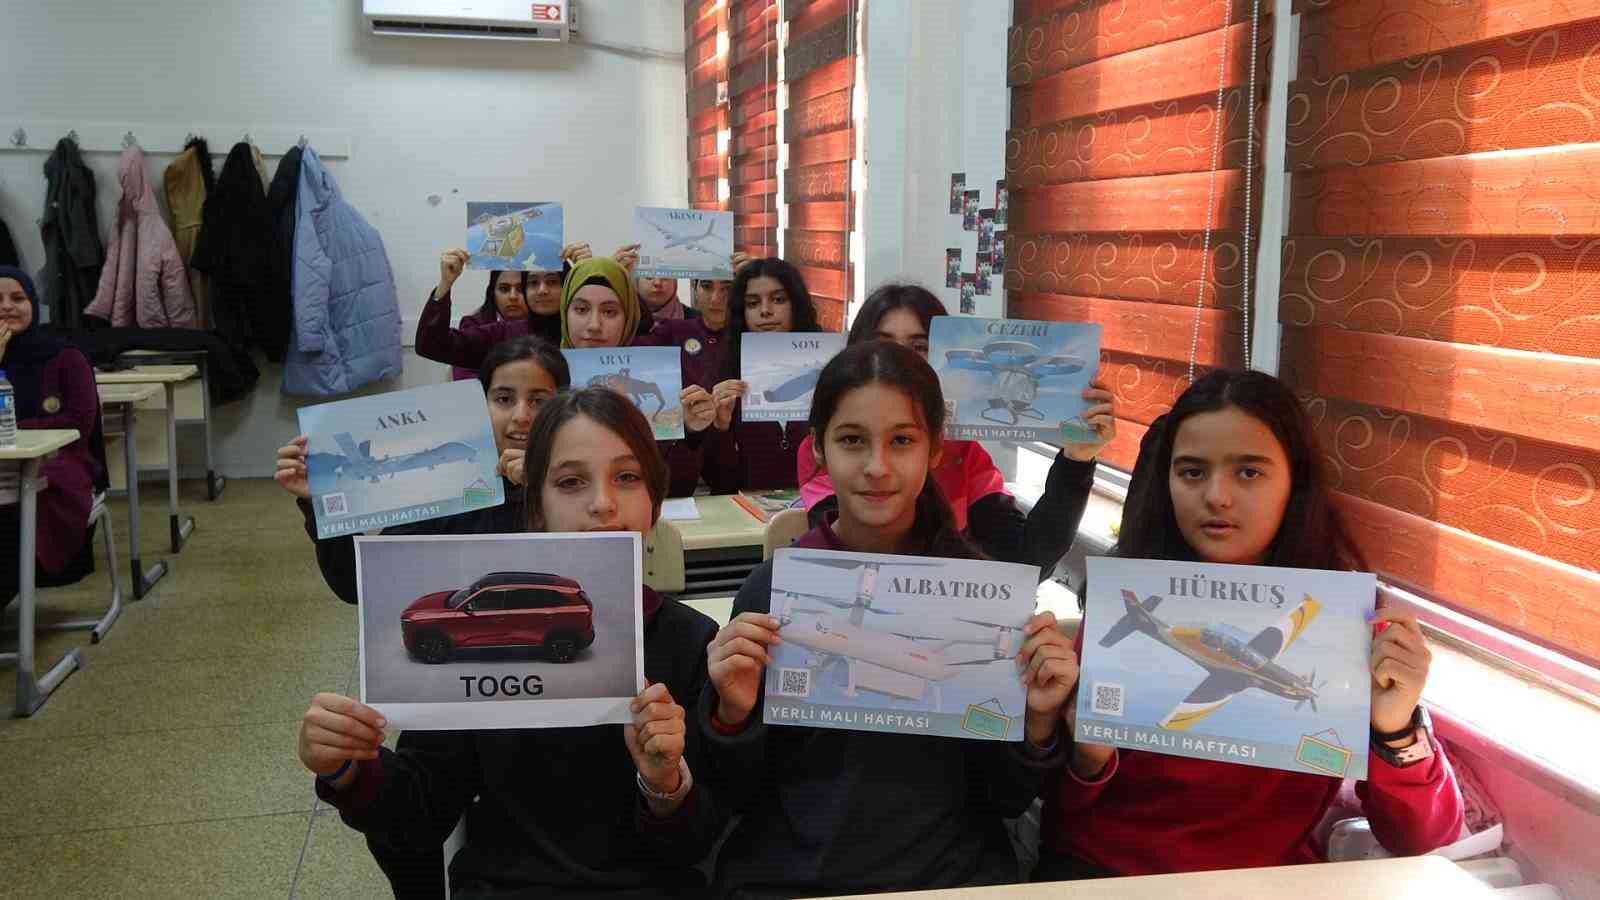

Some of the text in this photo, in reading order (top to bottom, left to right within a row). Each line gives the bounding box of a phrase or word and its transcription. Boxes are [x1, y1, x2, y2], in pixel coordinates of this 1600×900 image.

[791, 339, 821, 350] SOM
[598, 354, 633, 365] ARAT
[375, 409, 428, 430] ANKA
[391, 505, 441, 522] HAFTASI
[887, 577, 1013, 601] ALBATROS
[1168, 573, 1286, 609] HÜRKUŞ
[459, 674, 544, 698] TOGG
[820, 709, 858, 723] MALI
[863, 713, 930, 729] HAFTASI
[1082, 724, 1257, 759] YERLİ MALI HAFTASI
